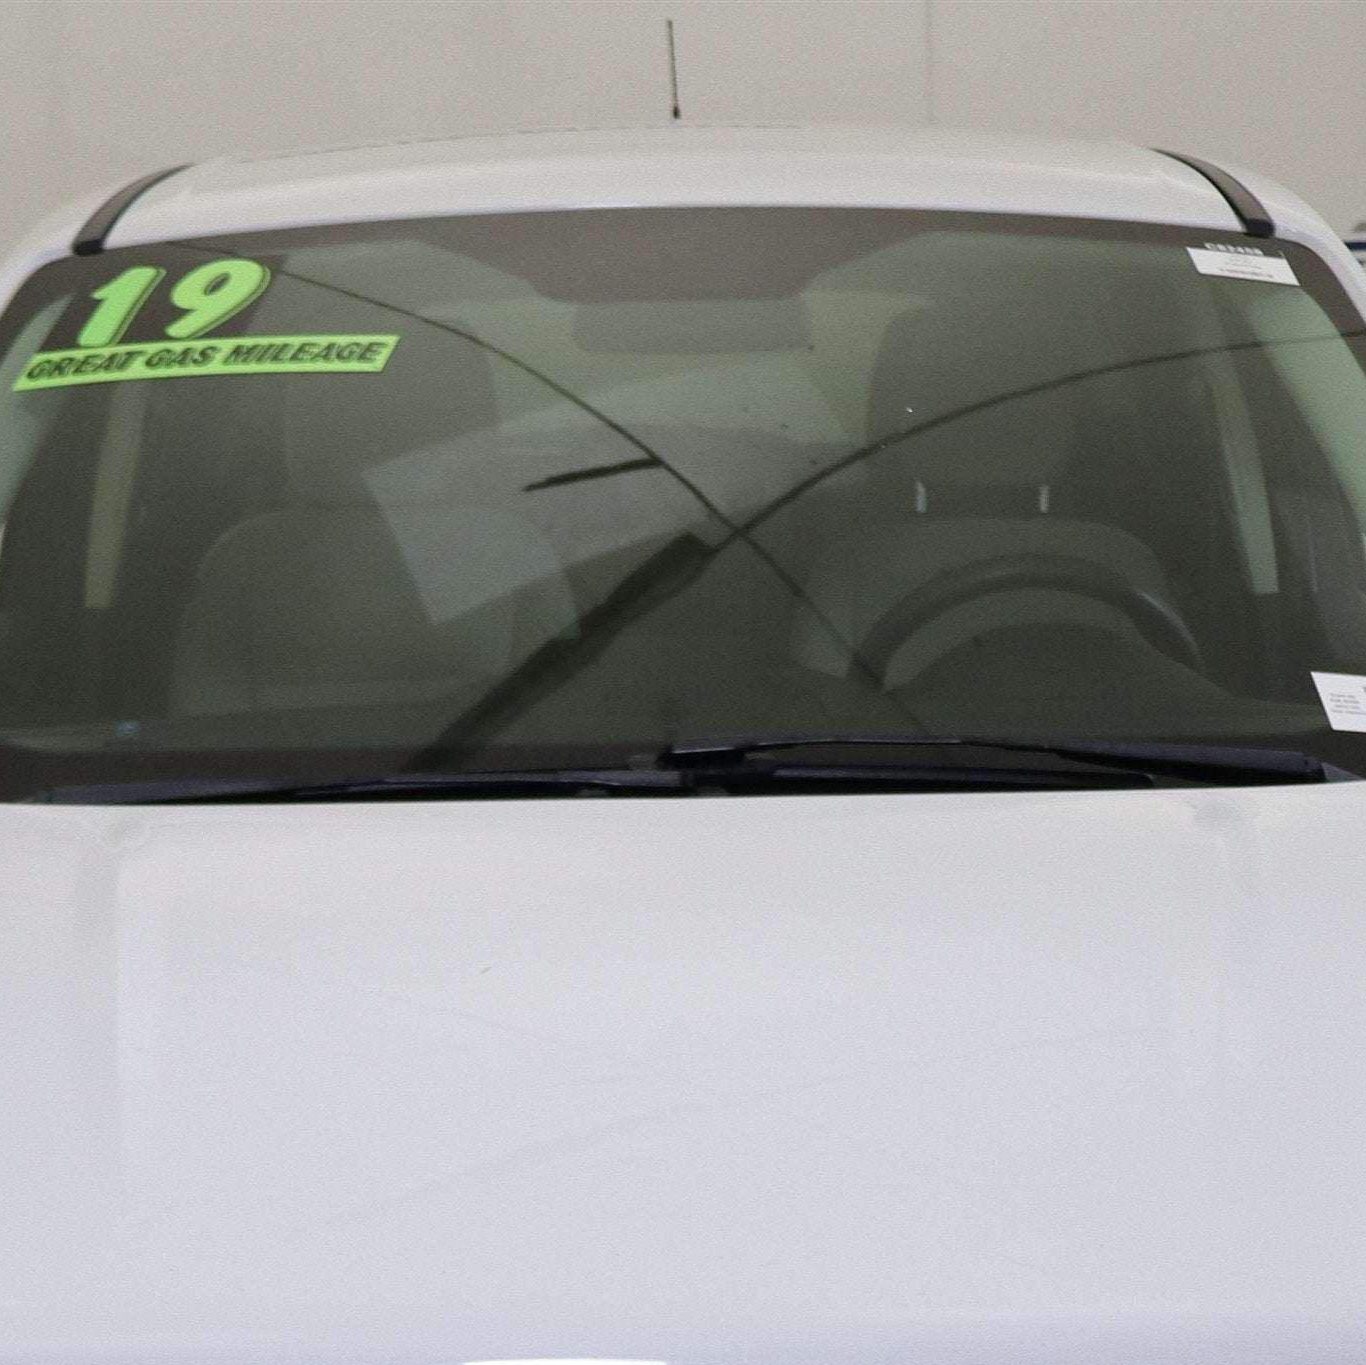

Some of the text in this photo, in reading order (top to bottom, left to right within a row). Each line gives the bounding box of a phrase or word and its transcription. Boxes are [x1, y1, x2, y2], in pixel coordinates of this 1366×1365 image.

[78, 258, 271, 347] 19
[25, 342, 387, 380] GREAT GAS MILEAGE
